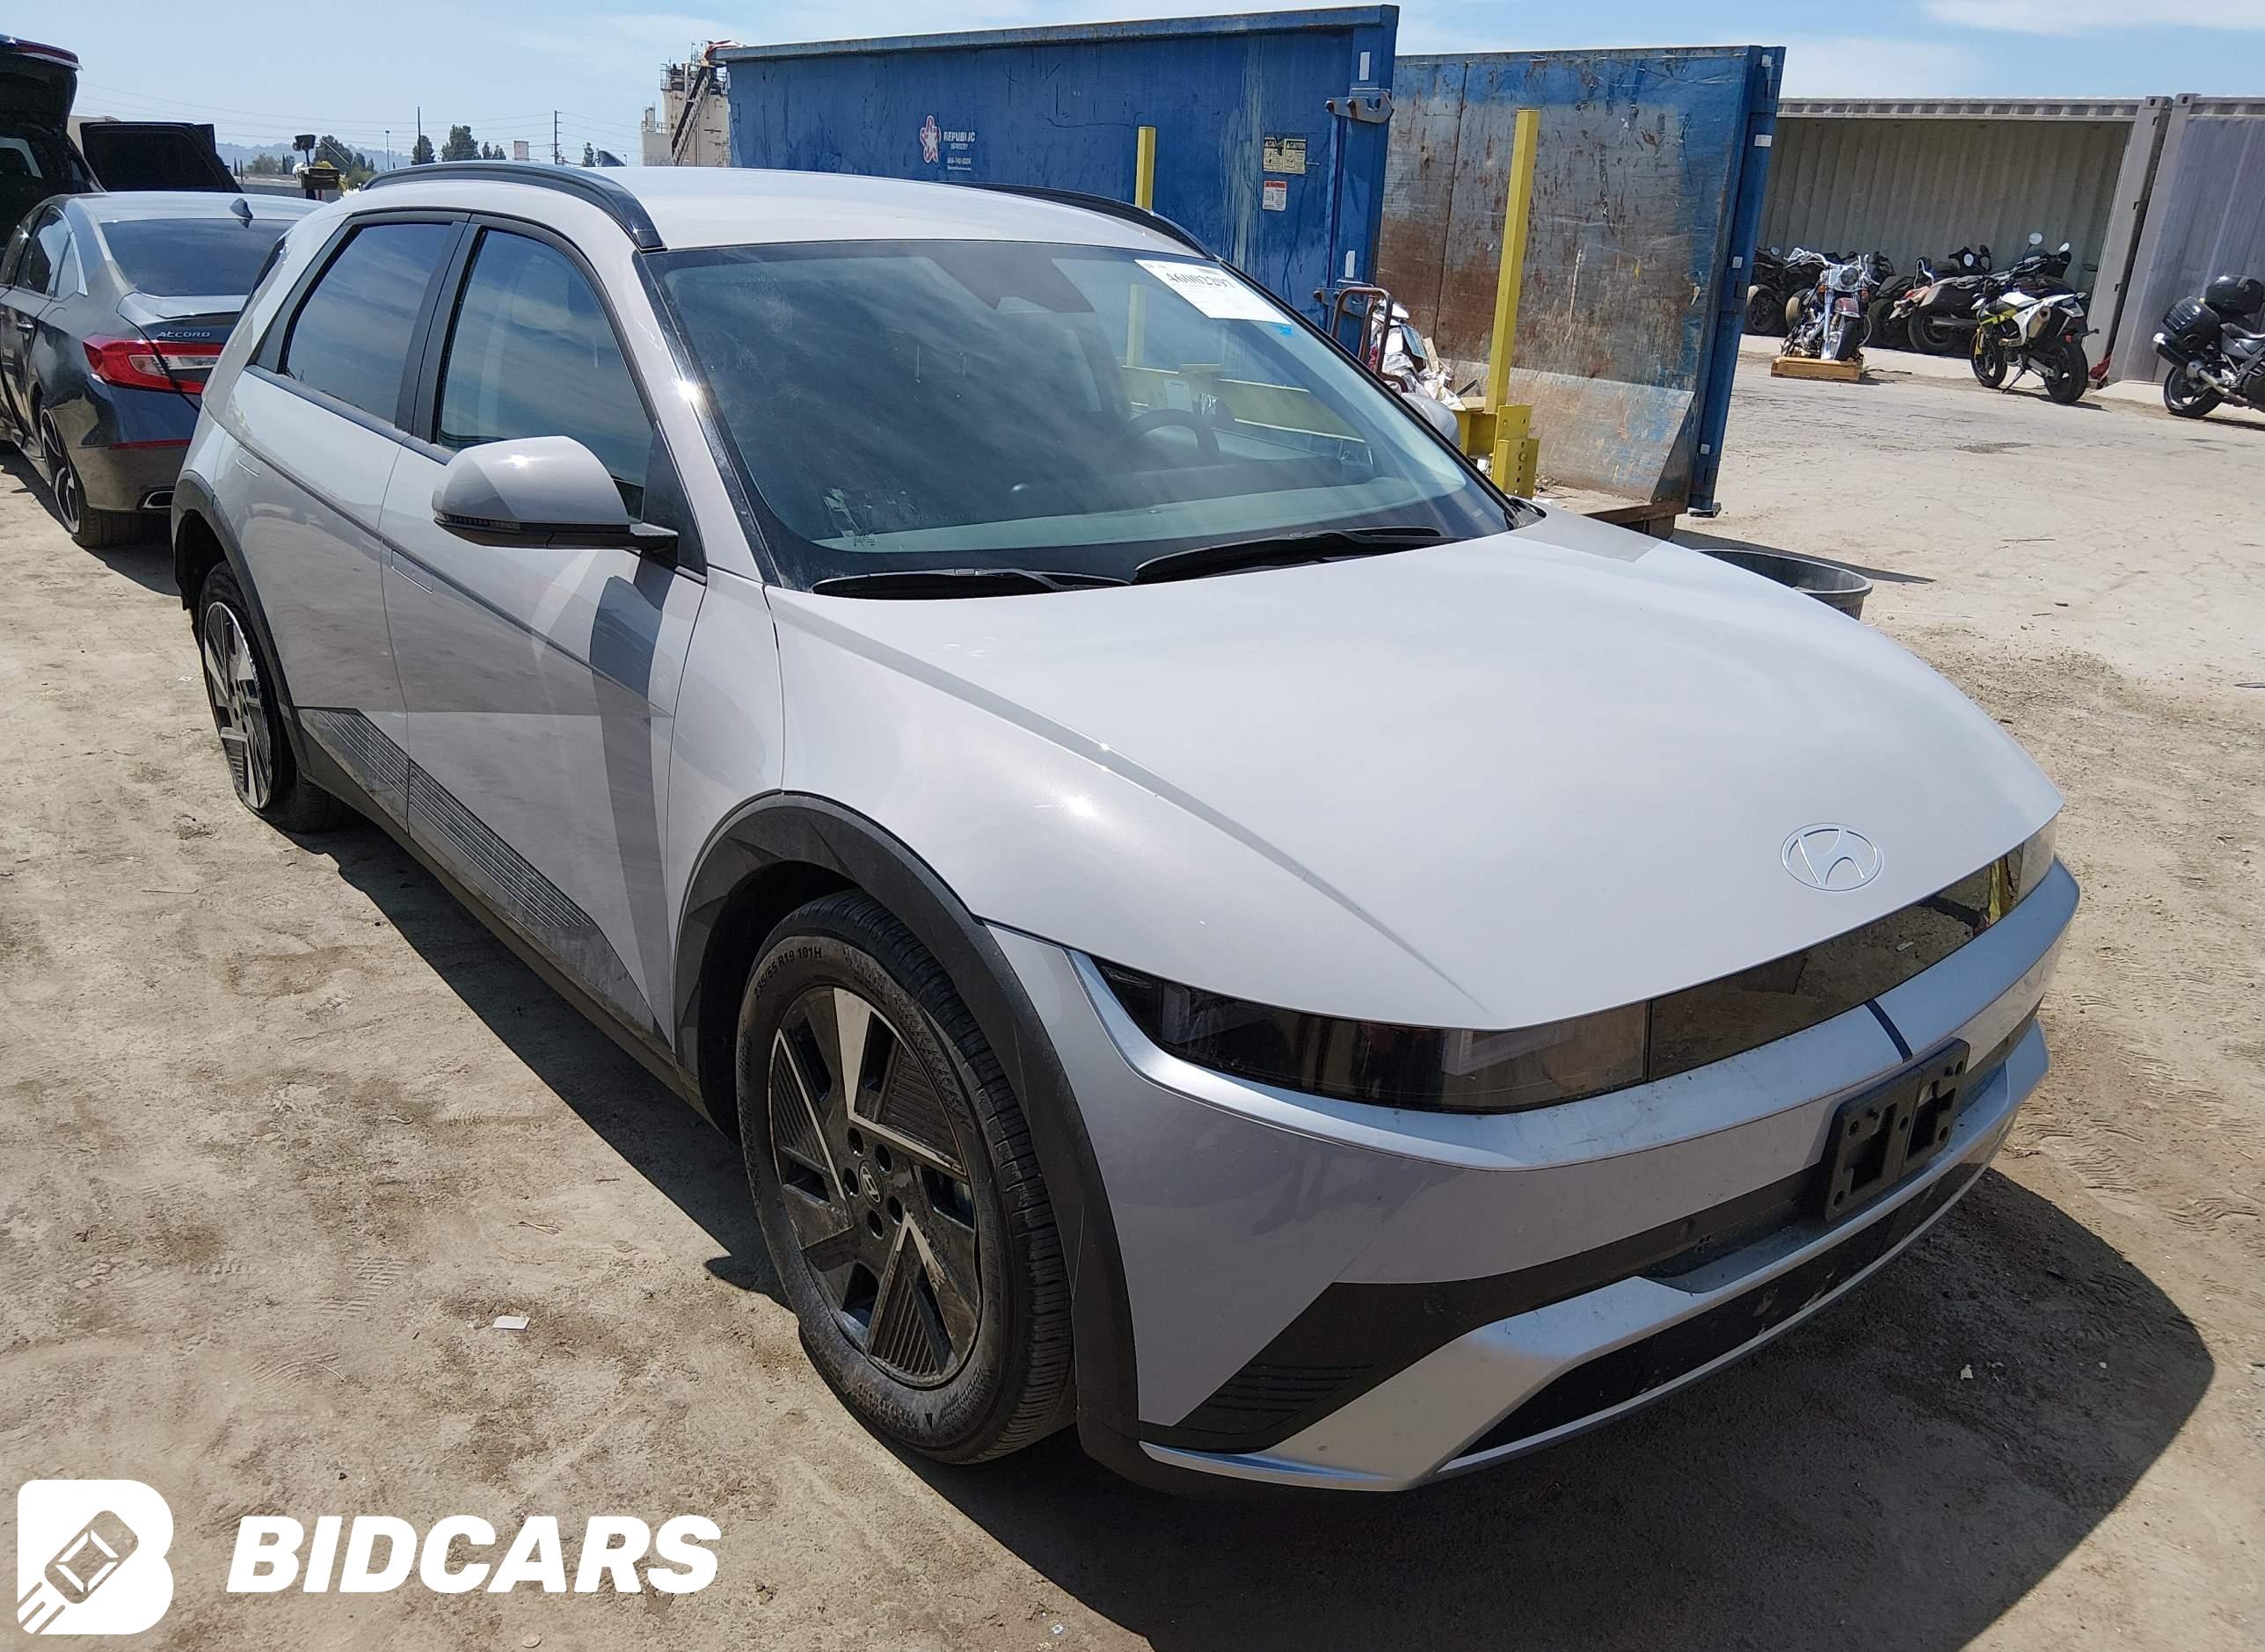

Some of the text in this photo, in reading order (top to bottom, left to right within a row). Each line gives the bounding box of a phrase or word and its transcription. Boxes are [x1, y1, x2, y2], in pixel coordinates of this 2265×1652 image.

[943, 131, 975, 142] REPUBLIC
[754, 946, 822, 1001] 235/55 R19 101H
